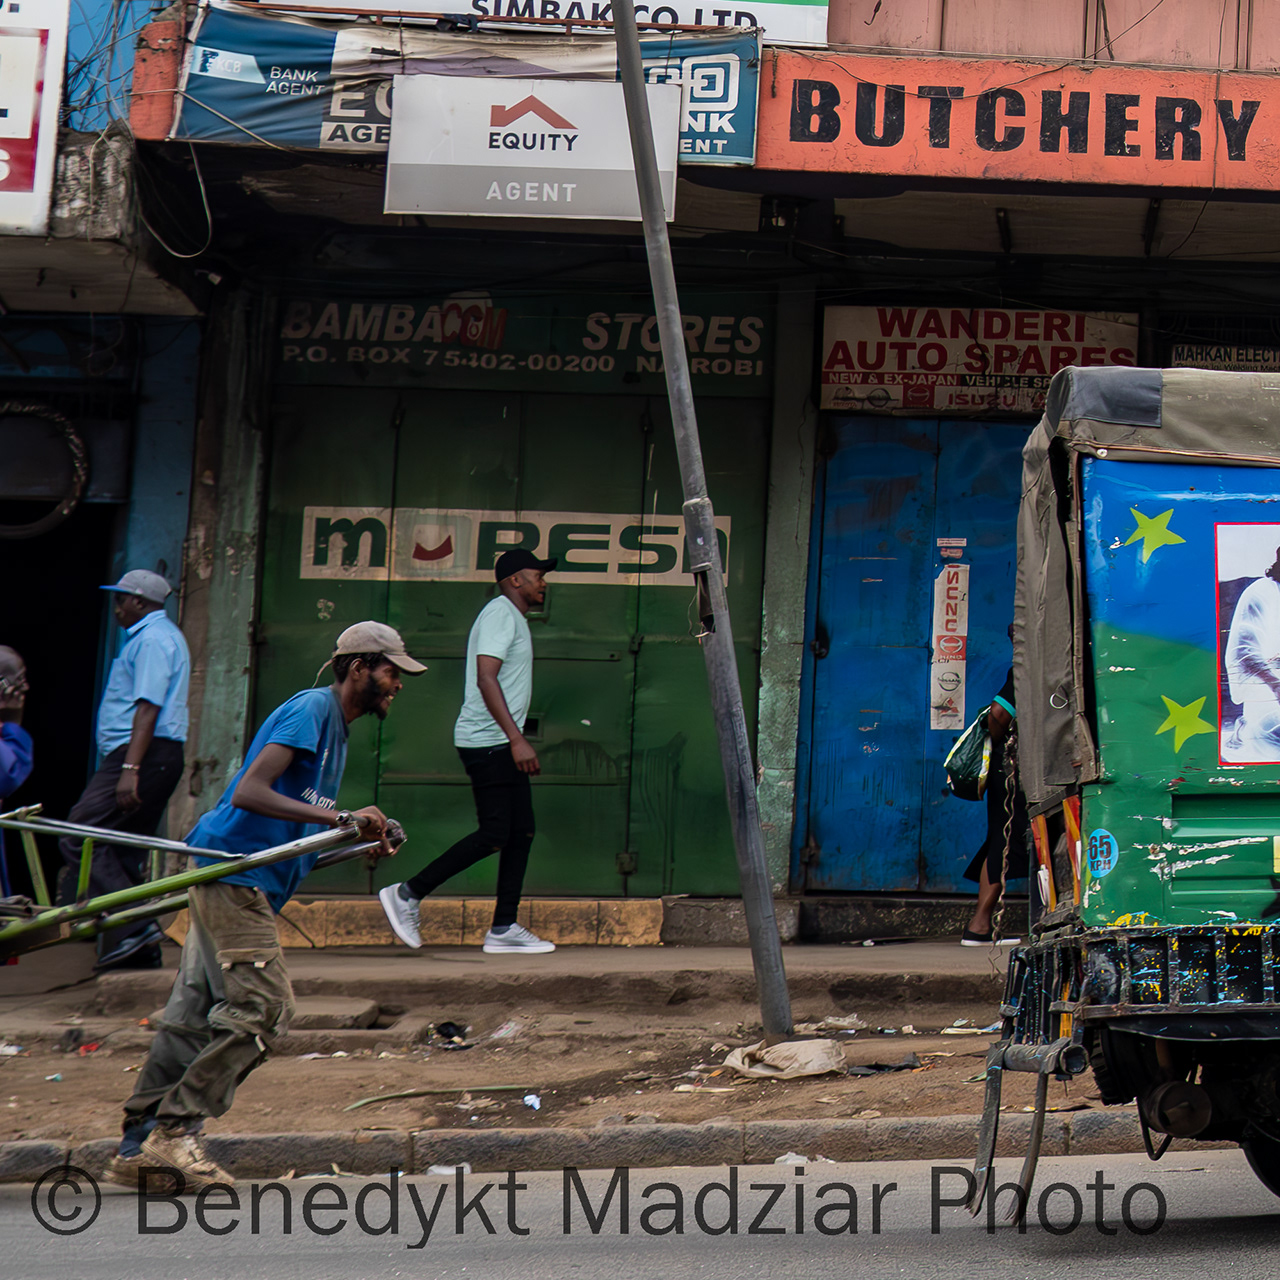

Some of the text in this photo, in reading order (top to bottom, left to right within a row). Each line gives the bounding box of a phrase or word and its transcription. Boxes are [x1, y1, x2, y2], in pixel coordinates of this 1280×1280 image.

[270, 66, 319, 82] BANK
[265, 81, 325, 96] AGENT
[680, 112, 736, 133] NK
[789, 78, 1262, 162] BUTCHERY
[327, 124, 390, 143] AGE
[488, 132, 579, 151] EQUITY
[680, 139, 728, 153] ENT
[486, 182, 577, 202] AGENT
[876, 306, 1086, 342] WANDERI
[346, 346, 411, 364] BOX
[825, 340, 1136, 374] AUTO SPARES
[1175, 346, 1232, 362] MAHKAN
[829, 373, 861, 384] NEW
[868, 373, 878, 384] &
[884, 373, 957, 386] EX-JAPAN
[965, 375, 1030, 388] VEHICLE
[1089, 835, 1111, 860] 65
[1090, 860, 1112, 872] KPH
